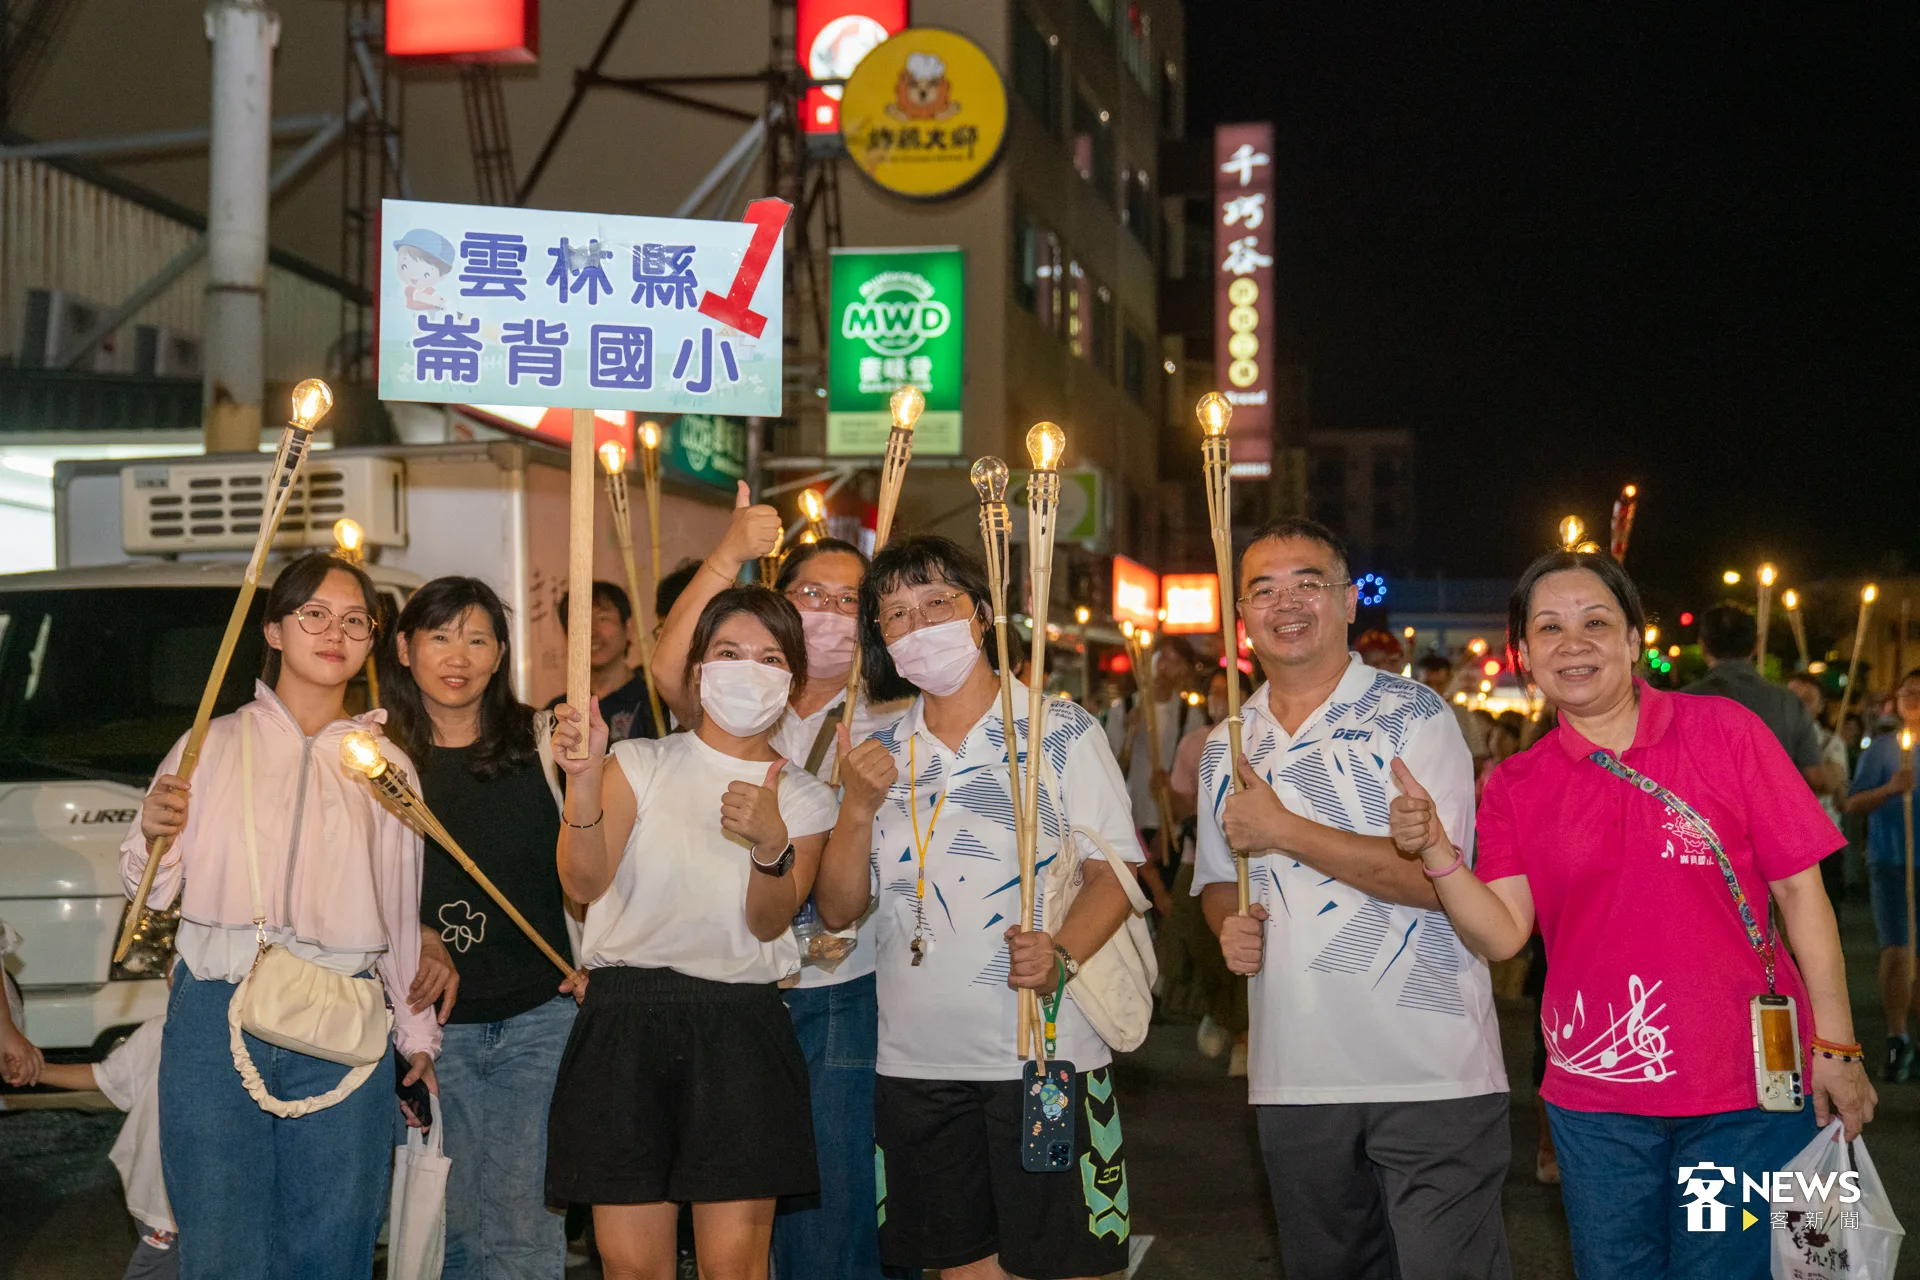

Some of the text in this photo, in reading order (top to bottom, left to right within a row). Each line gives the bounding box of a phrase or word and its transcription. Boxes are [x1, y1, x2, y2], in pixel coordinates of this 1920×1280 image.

[459, 231, 698, 310] 雲林縣
[412, 314, 740, 393] 崙背國小
[845, 303, 947, 336] MWD
